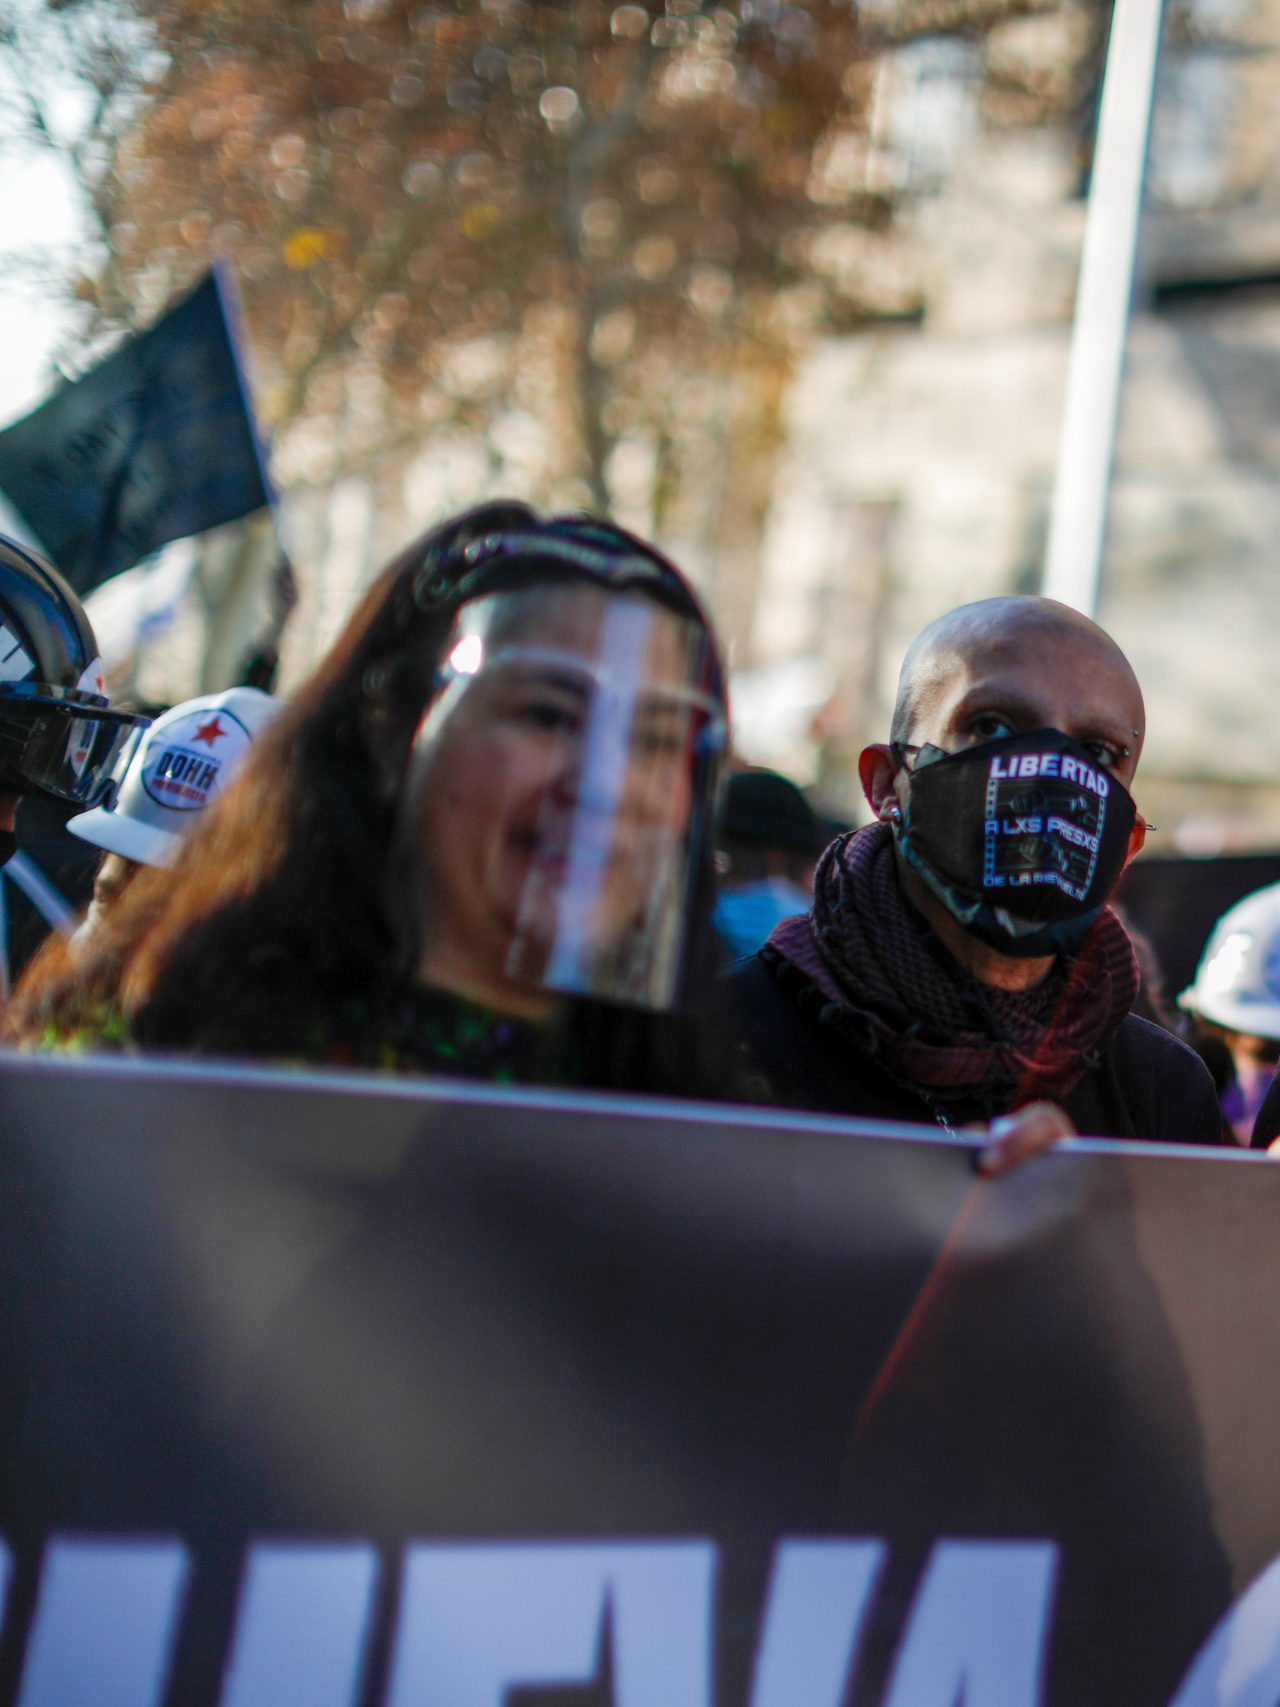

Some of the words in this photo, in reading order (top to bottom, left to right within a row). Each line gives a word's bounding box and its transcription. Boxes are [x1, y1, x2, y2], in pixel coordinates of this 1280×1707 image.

[989, 753, 1109, 798] LIBERTAD
[985, 819, 999, 836] A
[1003, 816, 1042, 835] LXS
[1047, 815, 1100, 853] PRESXS
[983, 874, 1006, 888] DE
[1009, 872, 1031, 886] LA
